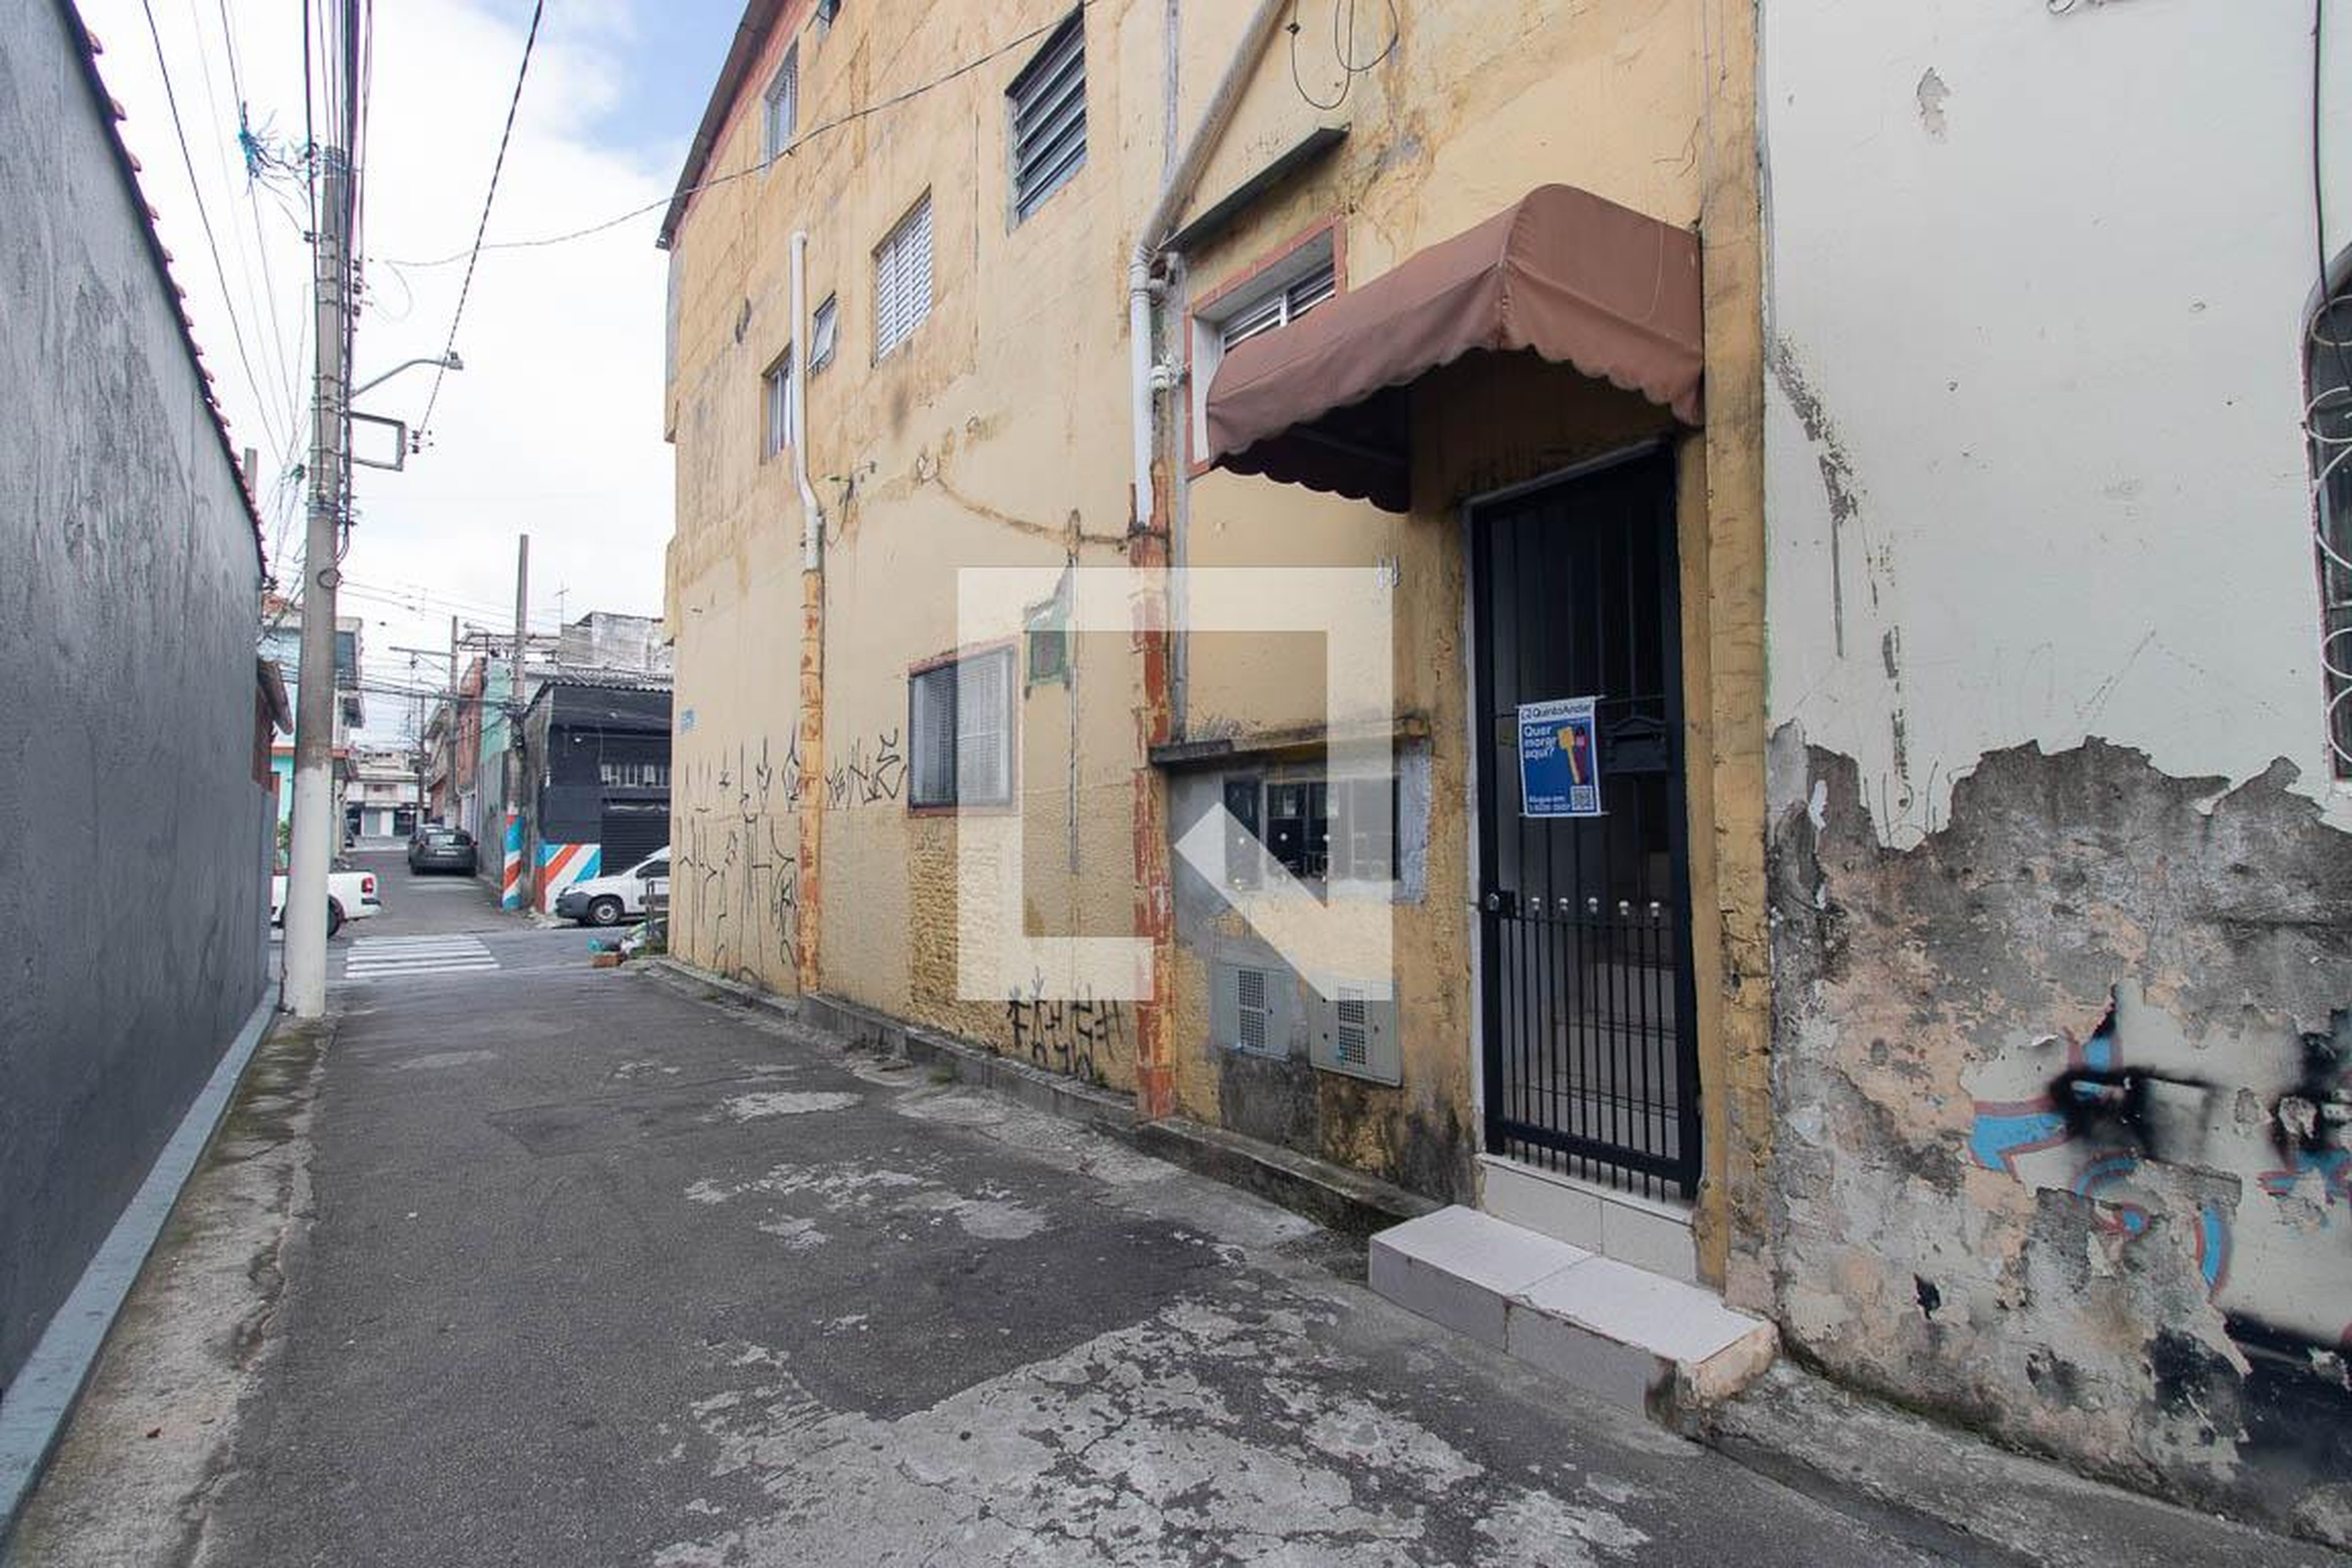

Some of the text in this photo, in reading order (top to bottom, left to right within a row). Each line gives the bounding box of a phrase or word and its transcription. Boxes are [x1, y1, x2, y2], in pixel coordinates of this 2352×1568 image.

[1533, 703, 1592, 718] QuintoAndar
[1524, 726, 1551, 737] Quer
[1525, 737, 1556, 747] morar
[1525, 747, 1555, 760] aqui?
